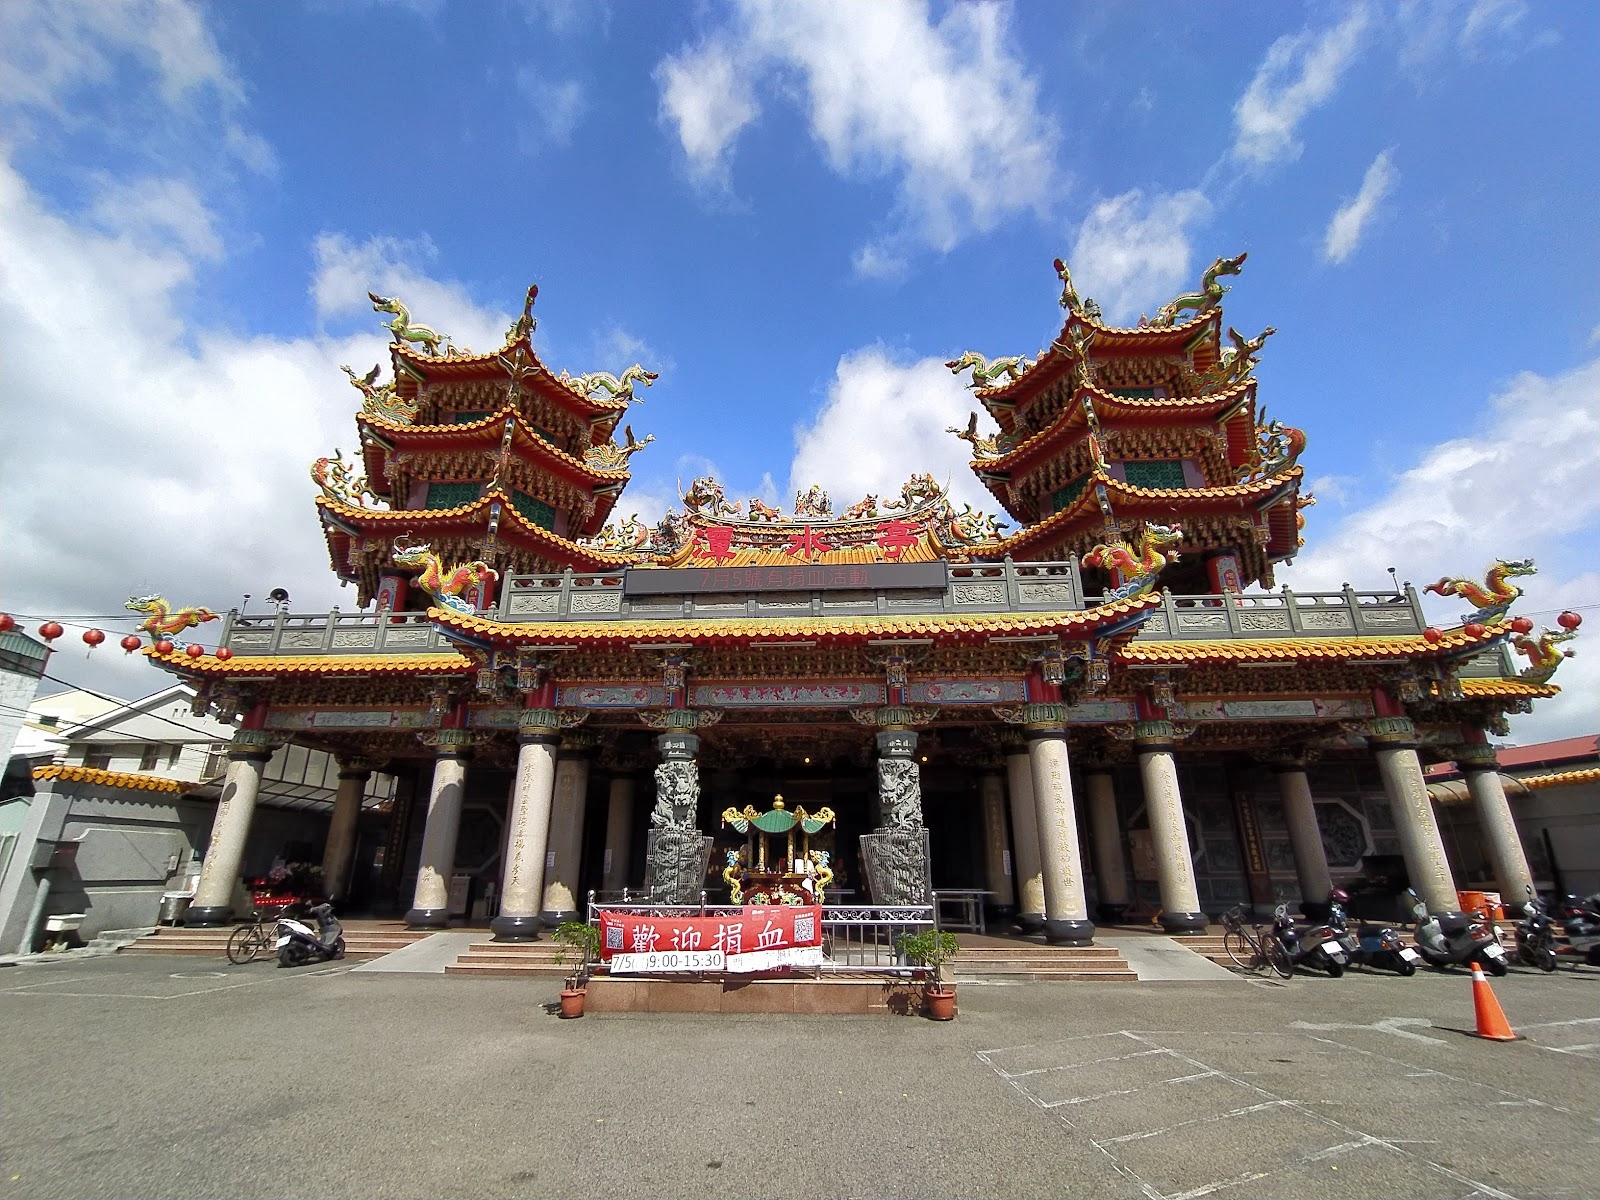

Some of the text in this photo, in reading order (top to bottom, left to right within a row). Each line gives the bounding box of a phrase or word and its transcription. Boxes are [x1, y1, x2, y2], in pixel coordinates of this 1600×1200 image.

[692, 520, 919, 562] 潭水亭
[700, 566, 868, 589] 7月5號有捐血活動
[631, 921, 788, 954] 歡迎捐血
[613, 953, 721, 971] 7/5()9:00-15:30
